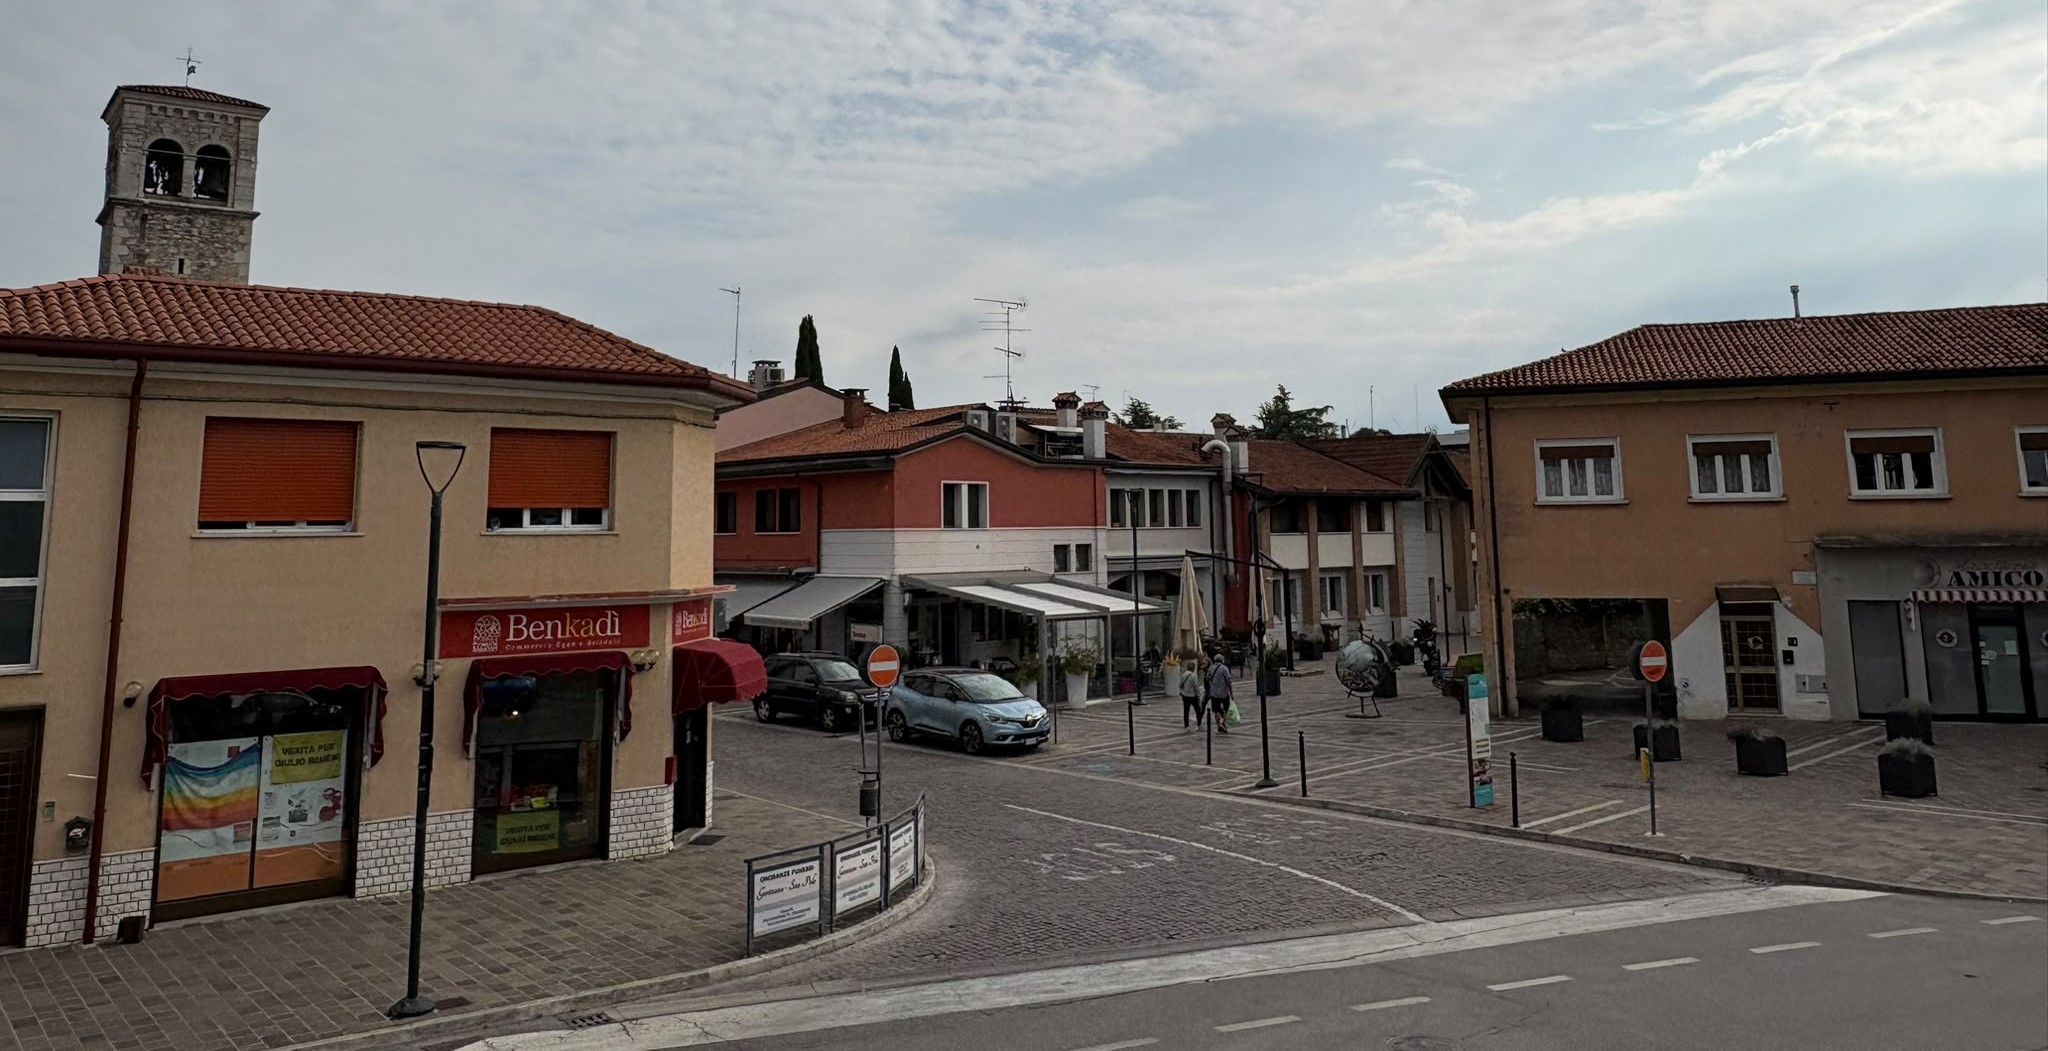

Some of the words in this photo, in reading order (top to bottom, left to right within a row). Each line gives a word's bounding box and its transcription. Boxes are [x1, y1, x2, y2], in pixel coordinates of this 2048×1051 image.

[1947, 570, 2044, 587] AMICO
[506, 610, 622, 641] Benkadì
[274, 757, 306, 767] GIULIO
